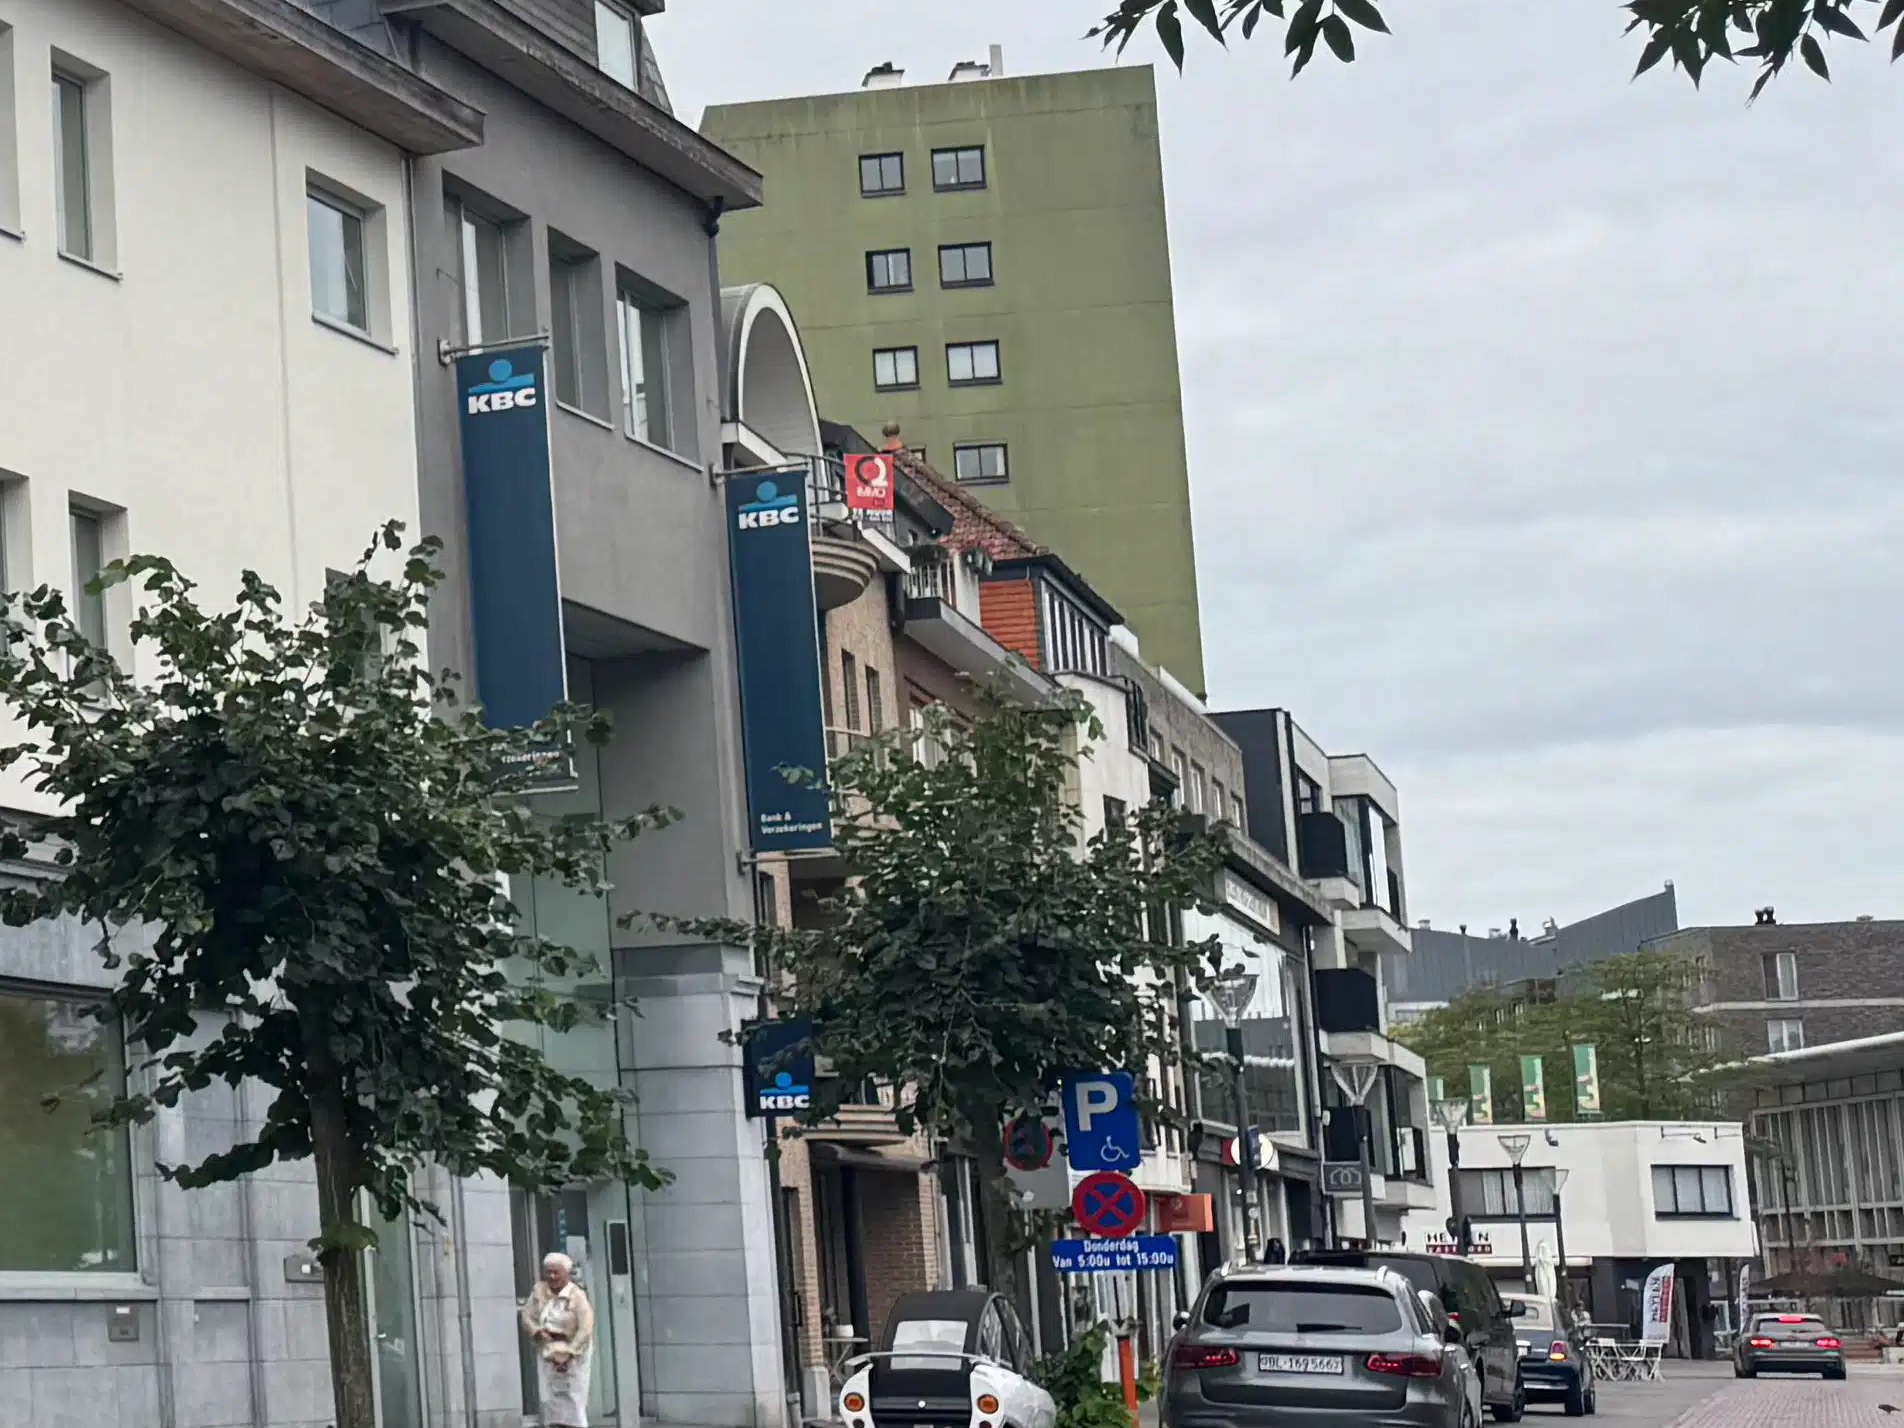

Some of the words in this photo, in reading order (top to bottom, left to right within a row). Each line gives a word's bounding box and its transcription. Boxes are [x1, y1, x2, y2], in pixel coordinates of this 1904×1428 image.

[468, 388, 536, 414] KBC
[739, 506, 799, 530] KBC
[760, 1095, 810, 1110] KBC
[1076, 1081, 1119, 1132] P
[1083, 1239, 1139, 1253] Donderdag
[1052, 1256, 1072, 1268] Van
[1077, 1253, 1111, 1268] 5:00u
[1116, 1254, 1131, 1266] tot
[1136, 1252, 1174, 1265] 15:00u
